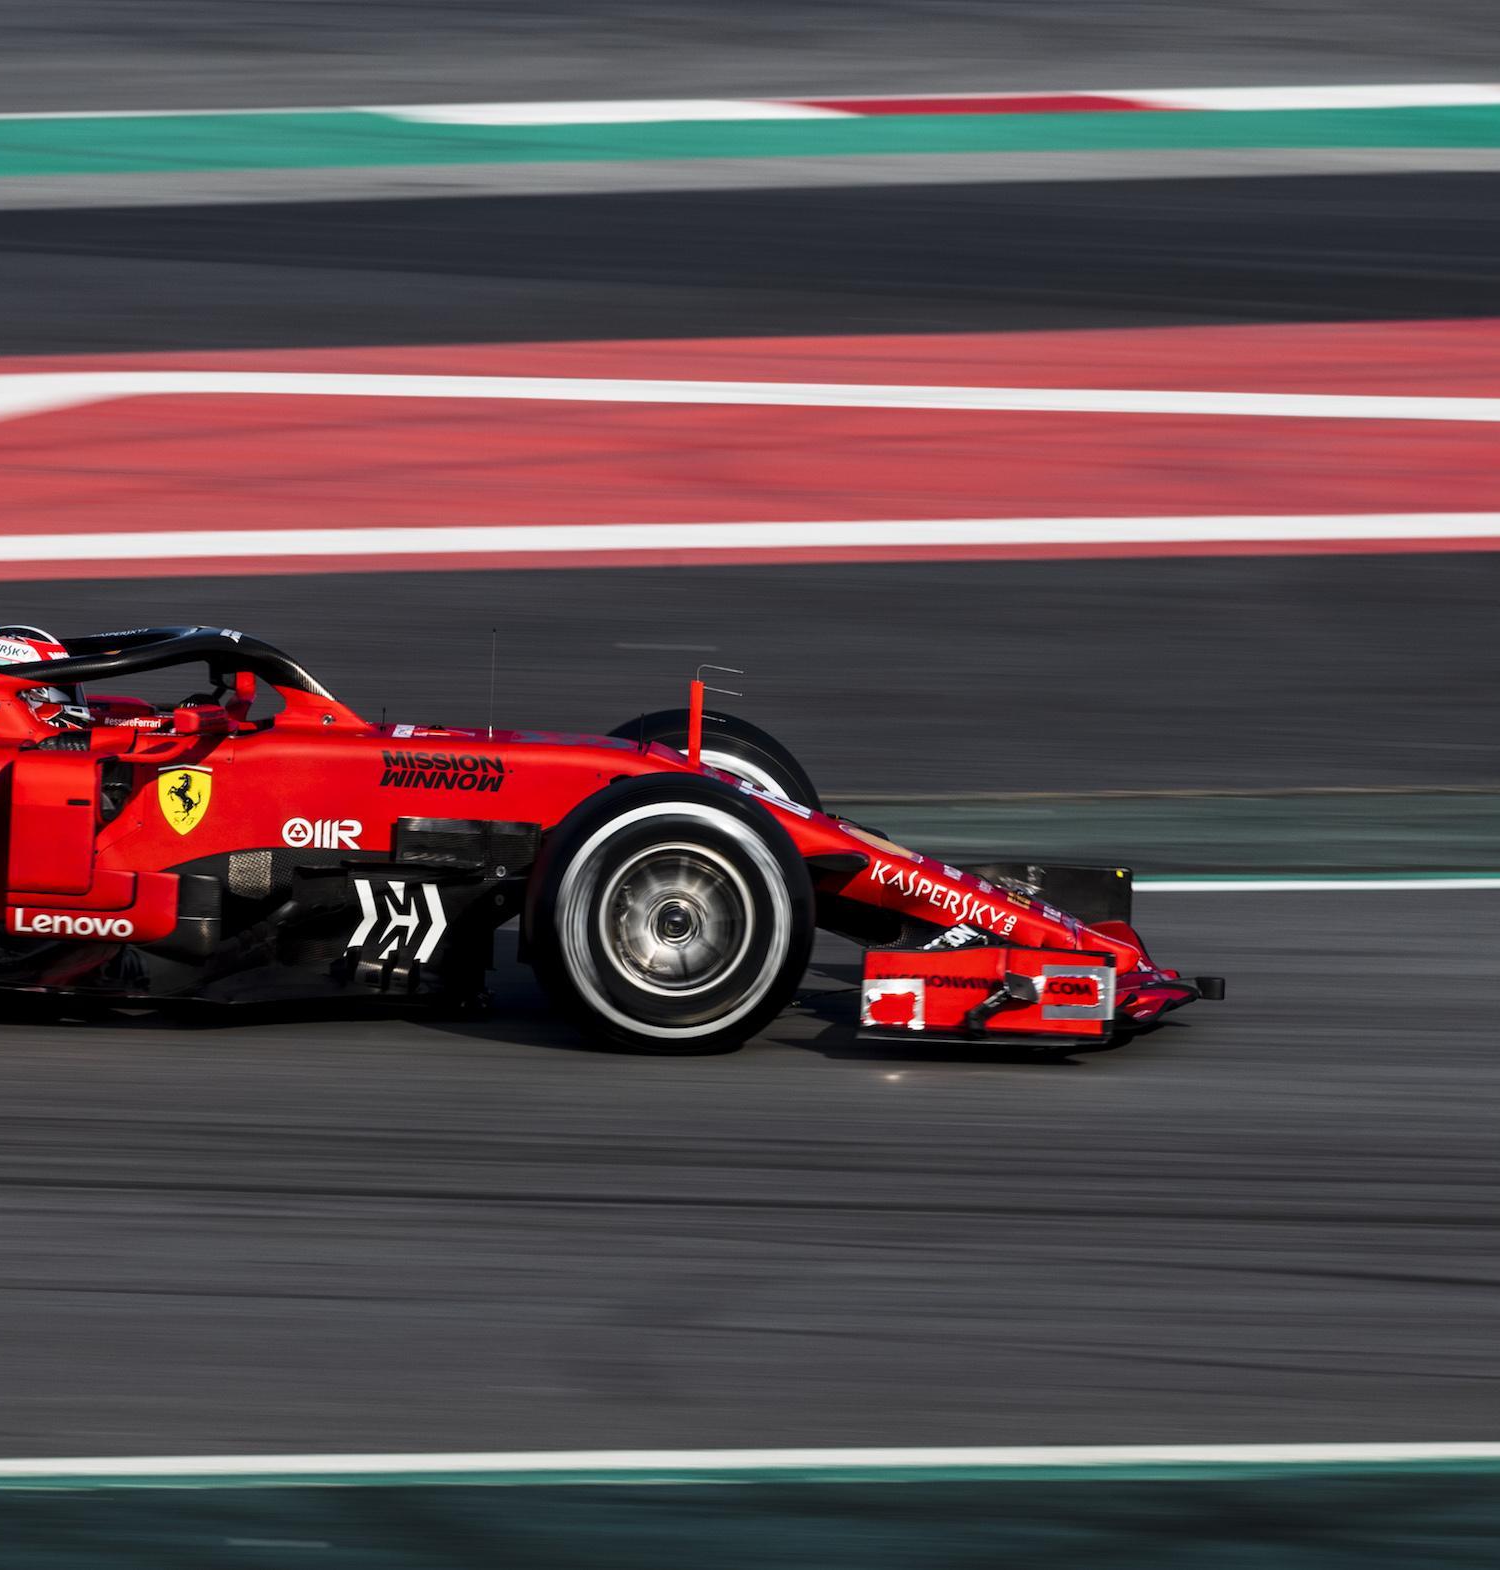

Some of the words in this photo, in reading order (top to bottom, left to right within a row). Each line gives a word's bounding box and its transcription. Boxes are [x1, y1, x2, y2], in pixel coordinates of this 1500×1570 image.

[381, 750, 504, 774] MISSION
[379, 768, 504, 792] WINNOW
[870, 860, 1006, 930] KASPERSKY
[14, 907, 134, 938] Lenovo
[999, 915, 1018, 937] lab
